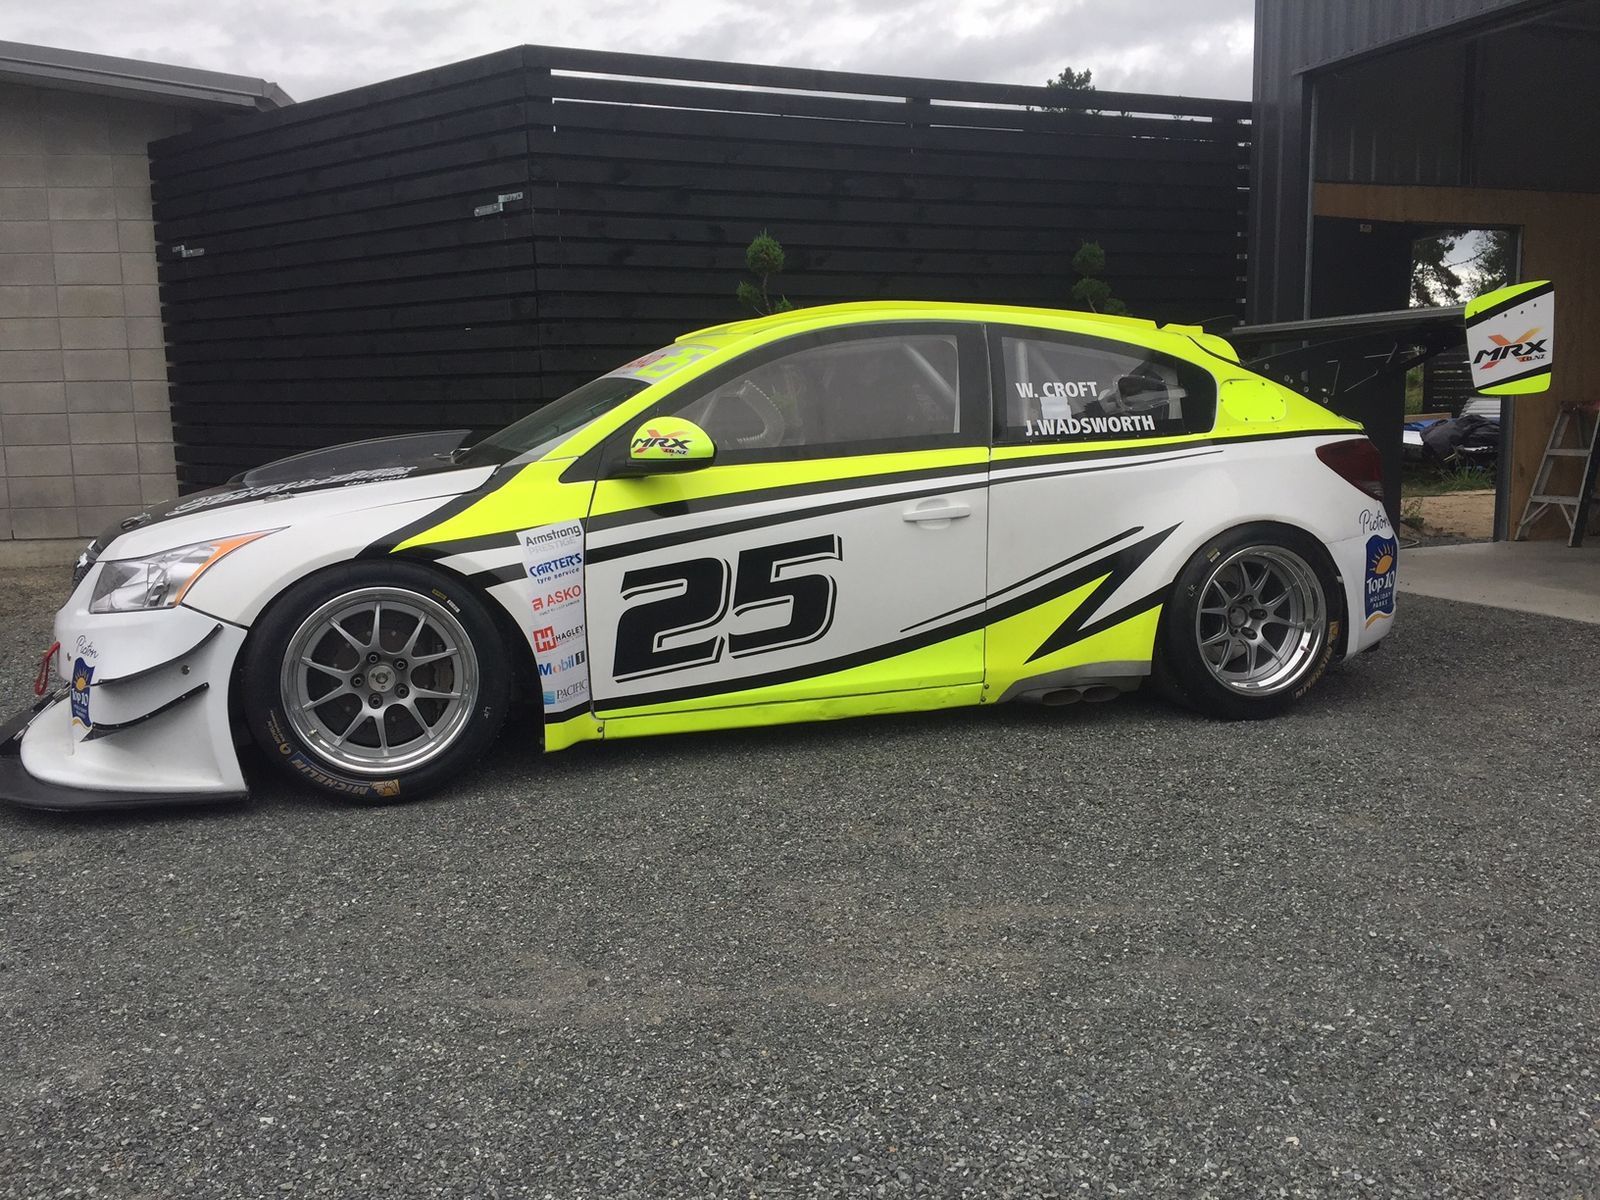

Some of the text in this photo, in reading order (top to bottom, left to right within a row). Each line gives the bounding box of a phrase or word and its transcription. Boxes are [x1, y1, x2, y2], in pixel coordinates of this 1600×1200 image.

[1472, 339, 1548, 364] MRX
[1015, 381, 1097, 398] W. CROFT
[1025, 415, 1156, 437] J.WADSWORTH
[631, 437, 692, 450] MRX
[526, 525, 581, 546] Armstrong
[528, 536, 577, 554] PRESTIGE
[529, 553, 582, 577] CARTER'S
[537, 567, 580, 584] tyre service
[1366, 570, 1395, 594] Top 10
[547, 585, 582, 607] ASKO
[613, 534, 843, 683] 25
[555, 625, 584, 642] HAGLEY
[538, 655, 574, 676] Mobil
[556, 679, 588, 700] PACIFIC
[291, 759, 370, 795] MICHELIN
